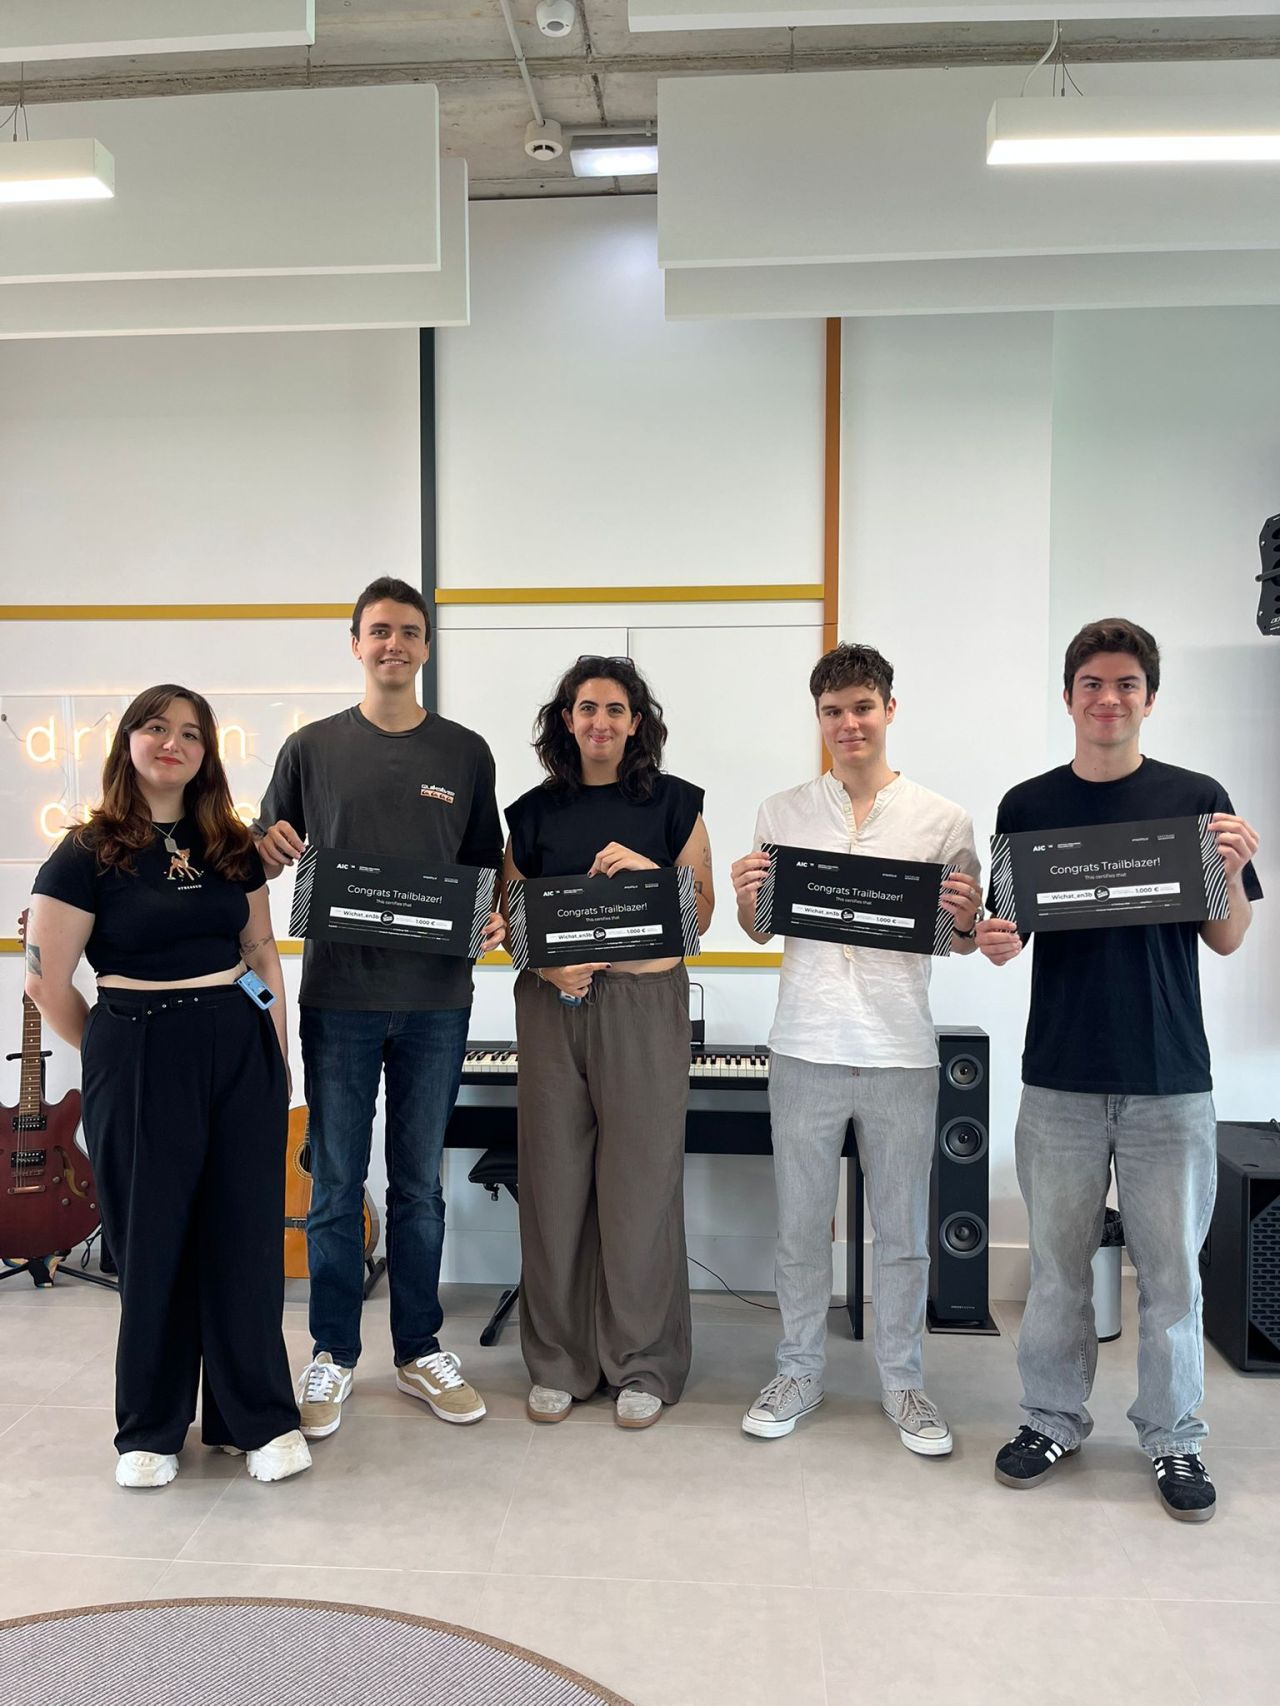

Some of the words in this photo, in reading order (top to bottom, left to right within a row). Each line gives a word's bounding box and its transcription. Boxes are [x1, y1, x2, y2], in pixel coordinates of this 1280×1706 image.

[26, 713, 247, 764] drin
[1032, 844, 1046, 852] AIC
[1049, 863, 1100, 875] Congrats
[1101, 857, 1161, 871] Trailblazer!
[347, 884, 391, 898] Congrats
[393, 889, 443, 904] Trailblazer!
[807, 882, 850, 895] Congrats
[852, 887, 904, 902] Trailblazer!
[557, 907, 598, 918] Congrats
[599, 902, 648, 914] Trailblazer!
